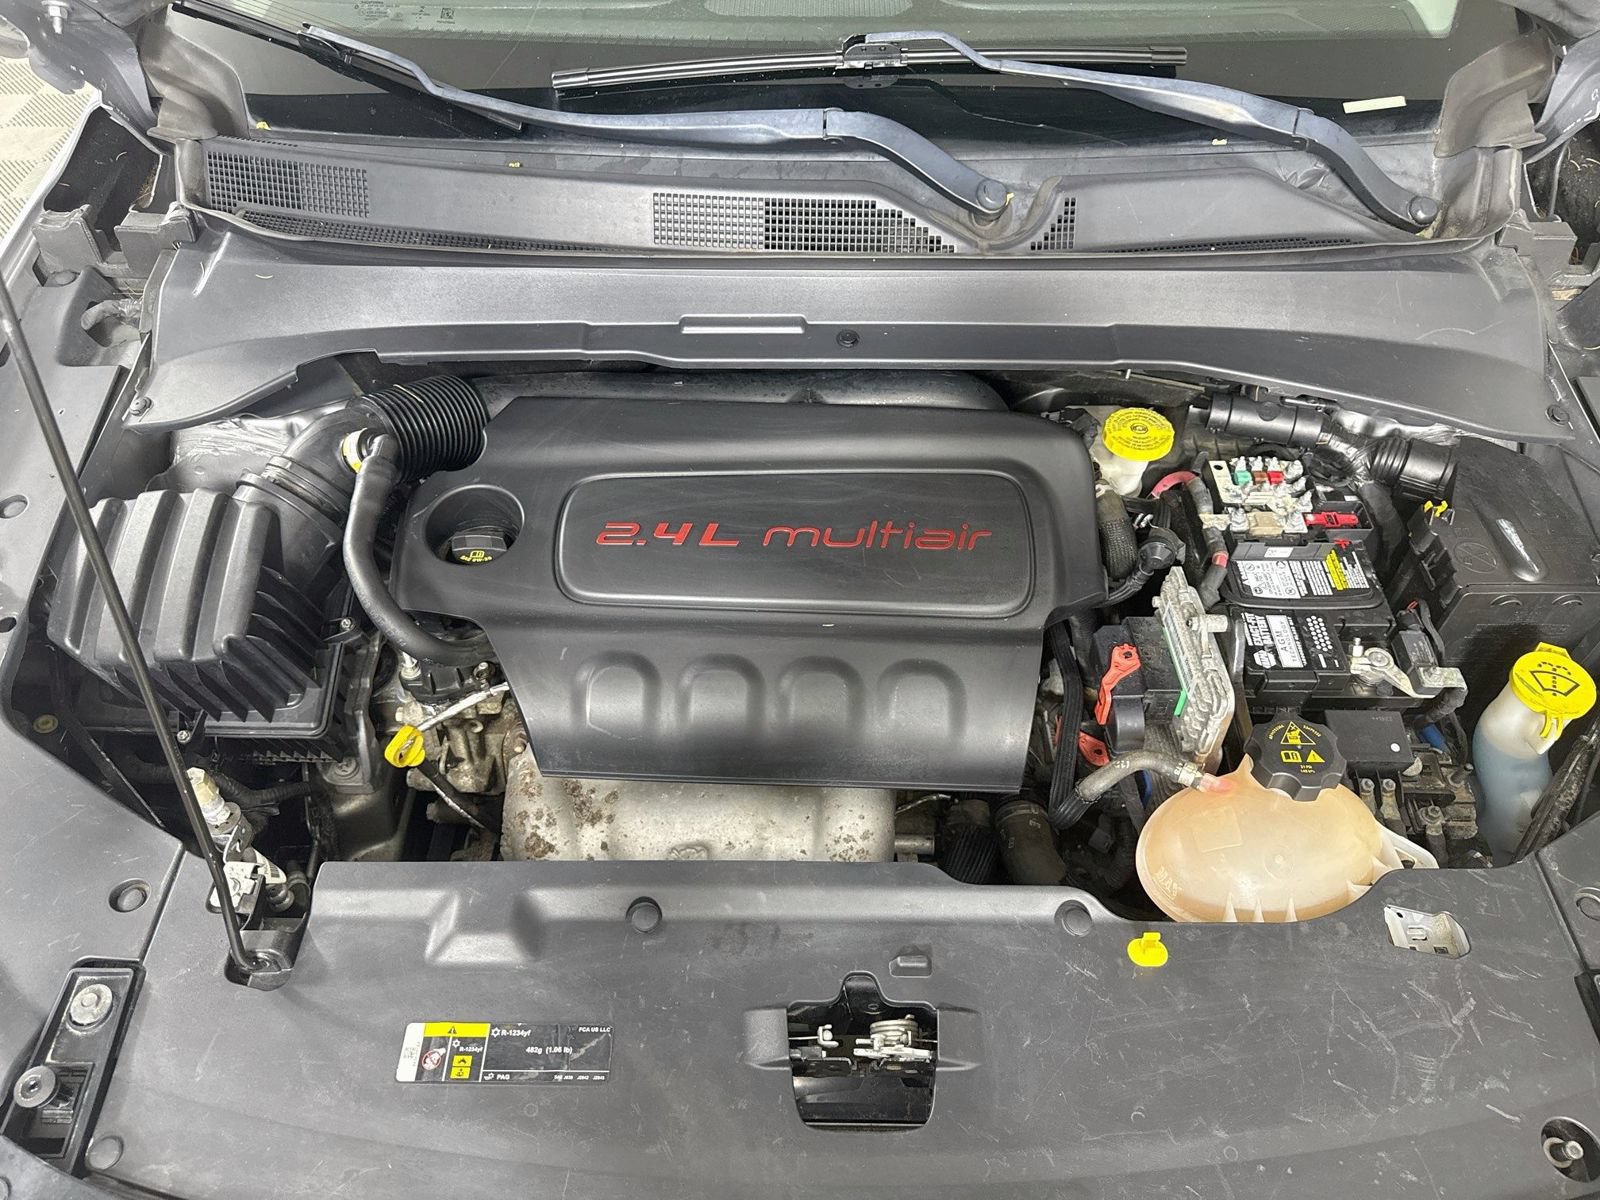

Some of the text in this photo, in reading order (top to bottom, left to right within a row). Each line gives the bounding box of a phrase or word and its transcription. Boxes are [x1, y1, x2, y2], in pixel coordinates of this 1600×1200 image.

[594, 519, 994, 552] 2.4L multiair
[1244, 611, 1264, 647] EXACT-FIT
[1254, 615, 1275, 646] BATTERY
[1275, 630, 1289, 652] AGM
[501, 1028, 532, 1038] R-1234yf
